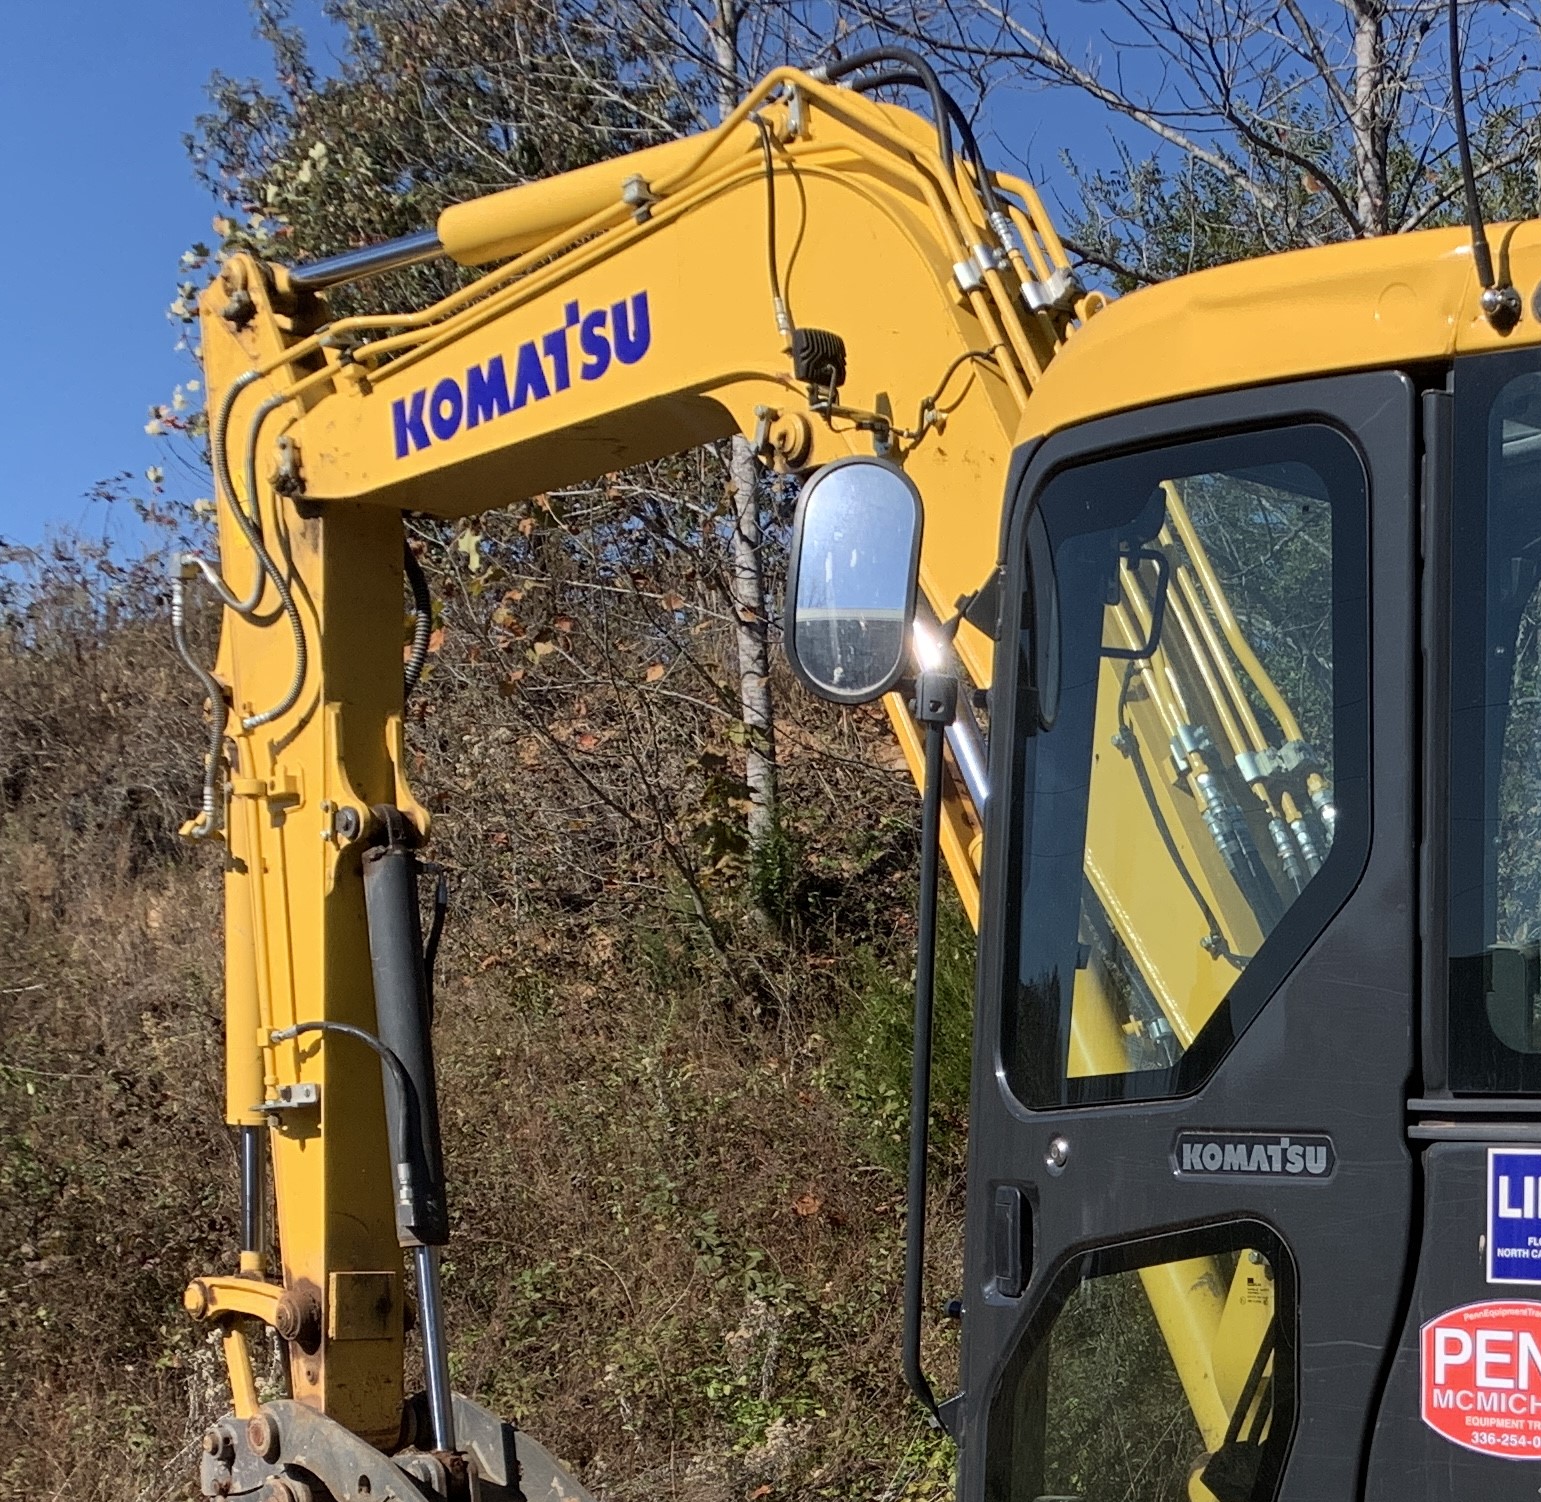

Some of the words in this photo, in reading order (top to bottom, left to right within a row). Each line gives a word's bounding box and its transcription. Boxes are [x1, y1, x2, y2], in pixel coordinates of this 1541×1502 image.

[392, 289, 652, 460] KOMATSU
[1182, 1137, 1327, 1174] KOMATSU
[1497, 1248, 1529, 1258] NORTH
[1465, 1416, 1525, 1429] EQUIPMENT
